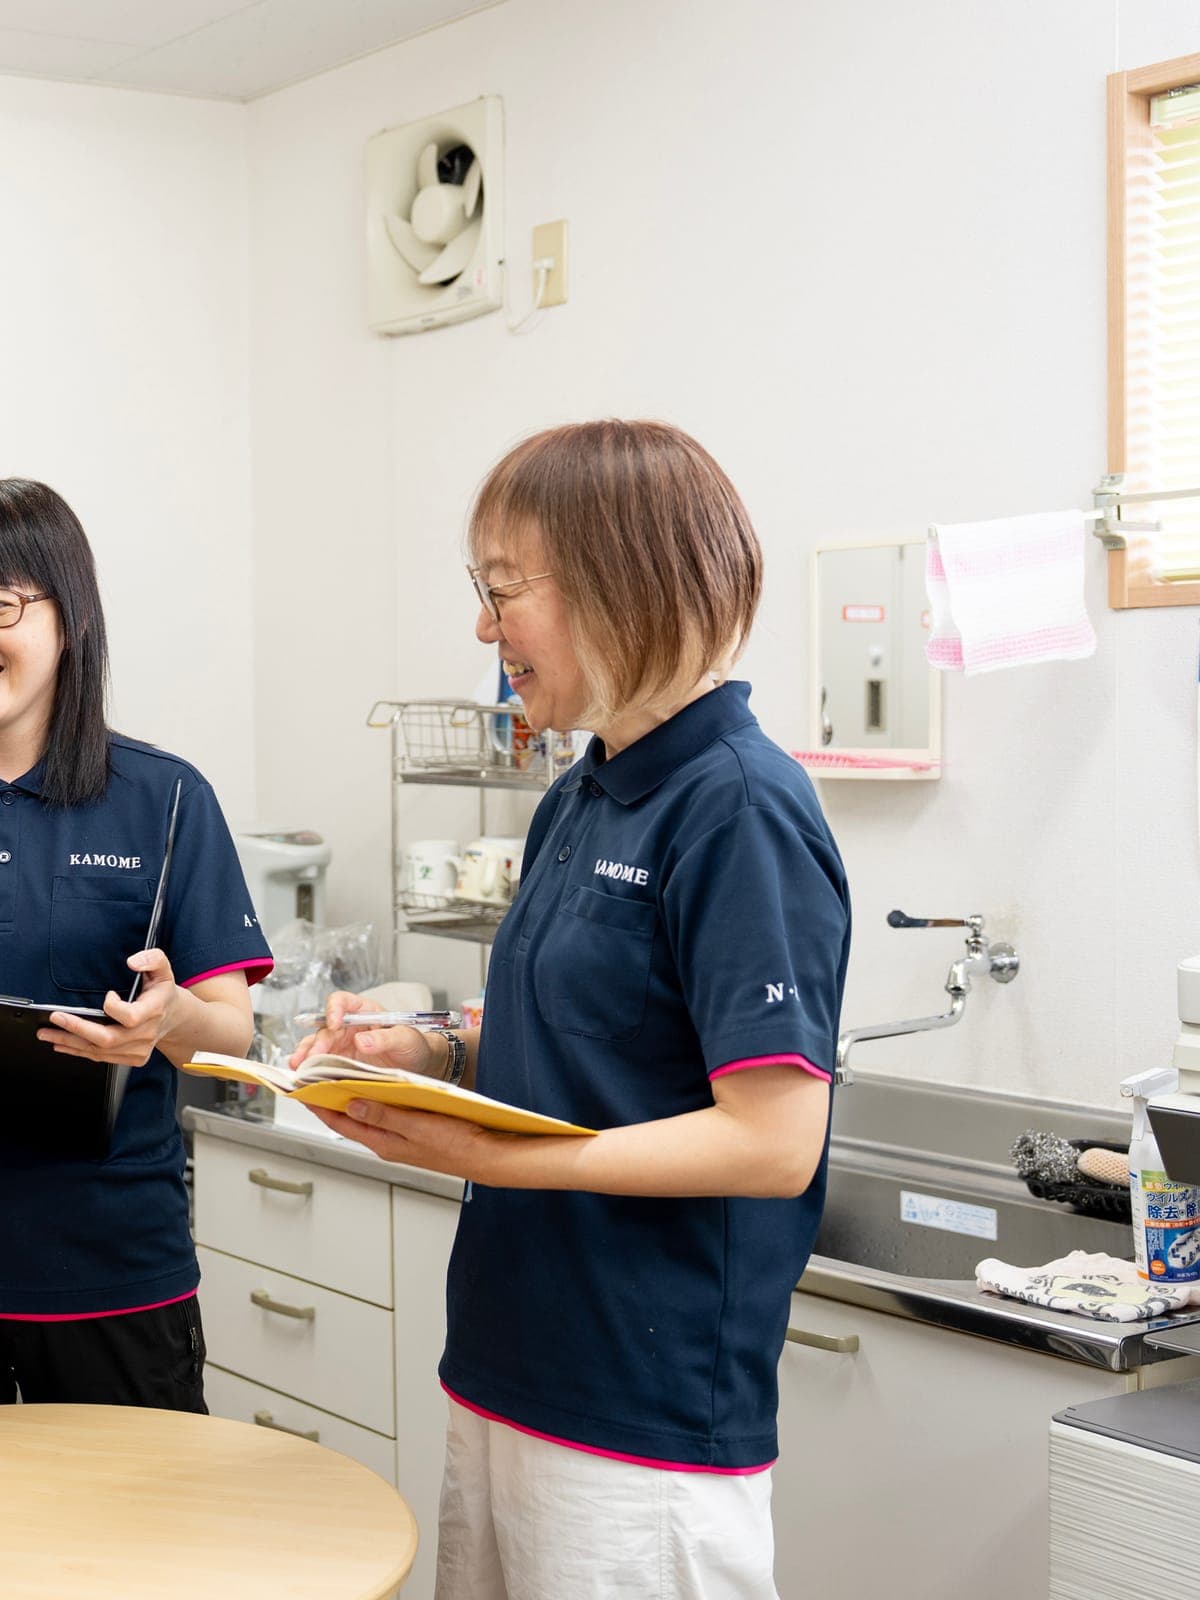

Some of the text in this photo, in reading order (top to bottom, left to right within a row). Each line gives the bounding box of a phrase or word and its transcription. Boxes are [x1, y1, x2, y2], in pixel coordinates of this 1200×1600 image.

[69, 853, 142, 869] KAMOME
[1147, 1200, 1200, 1219] 除去・除
